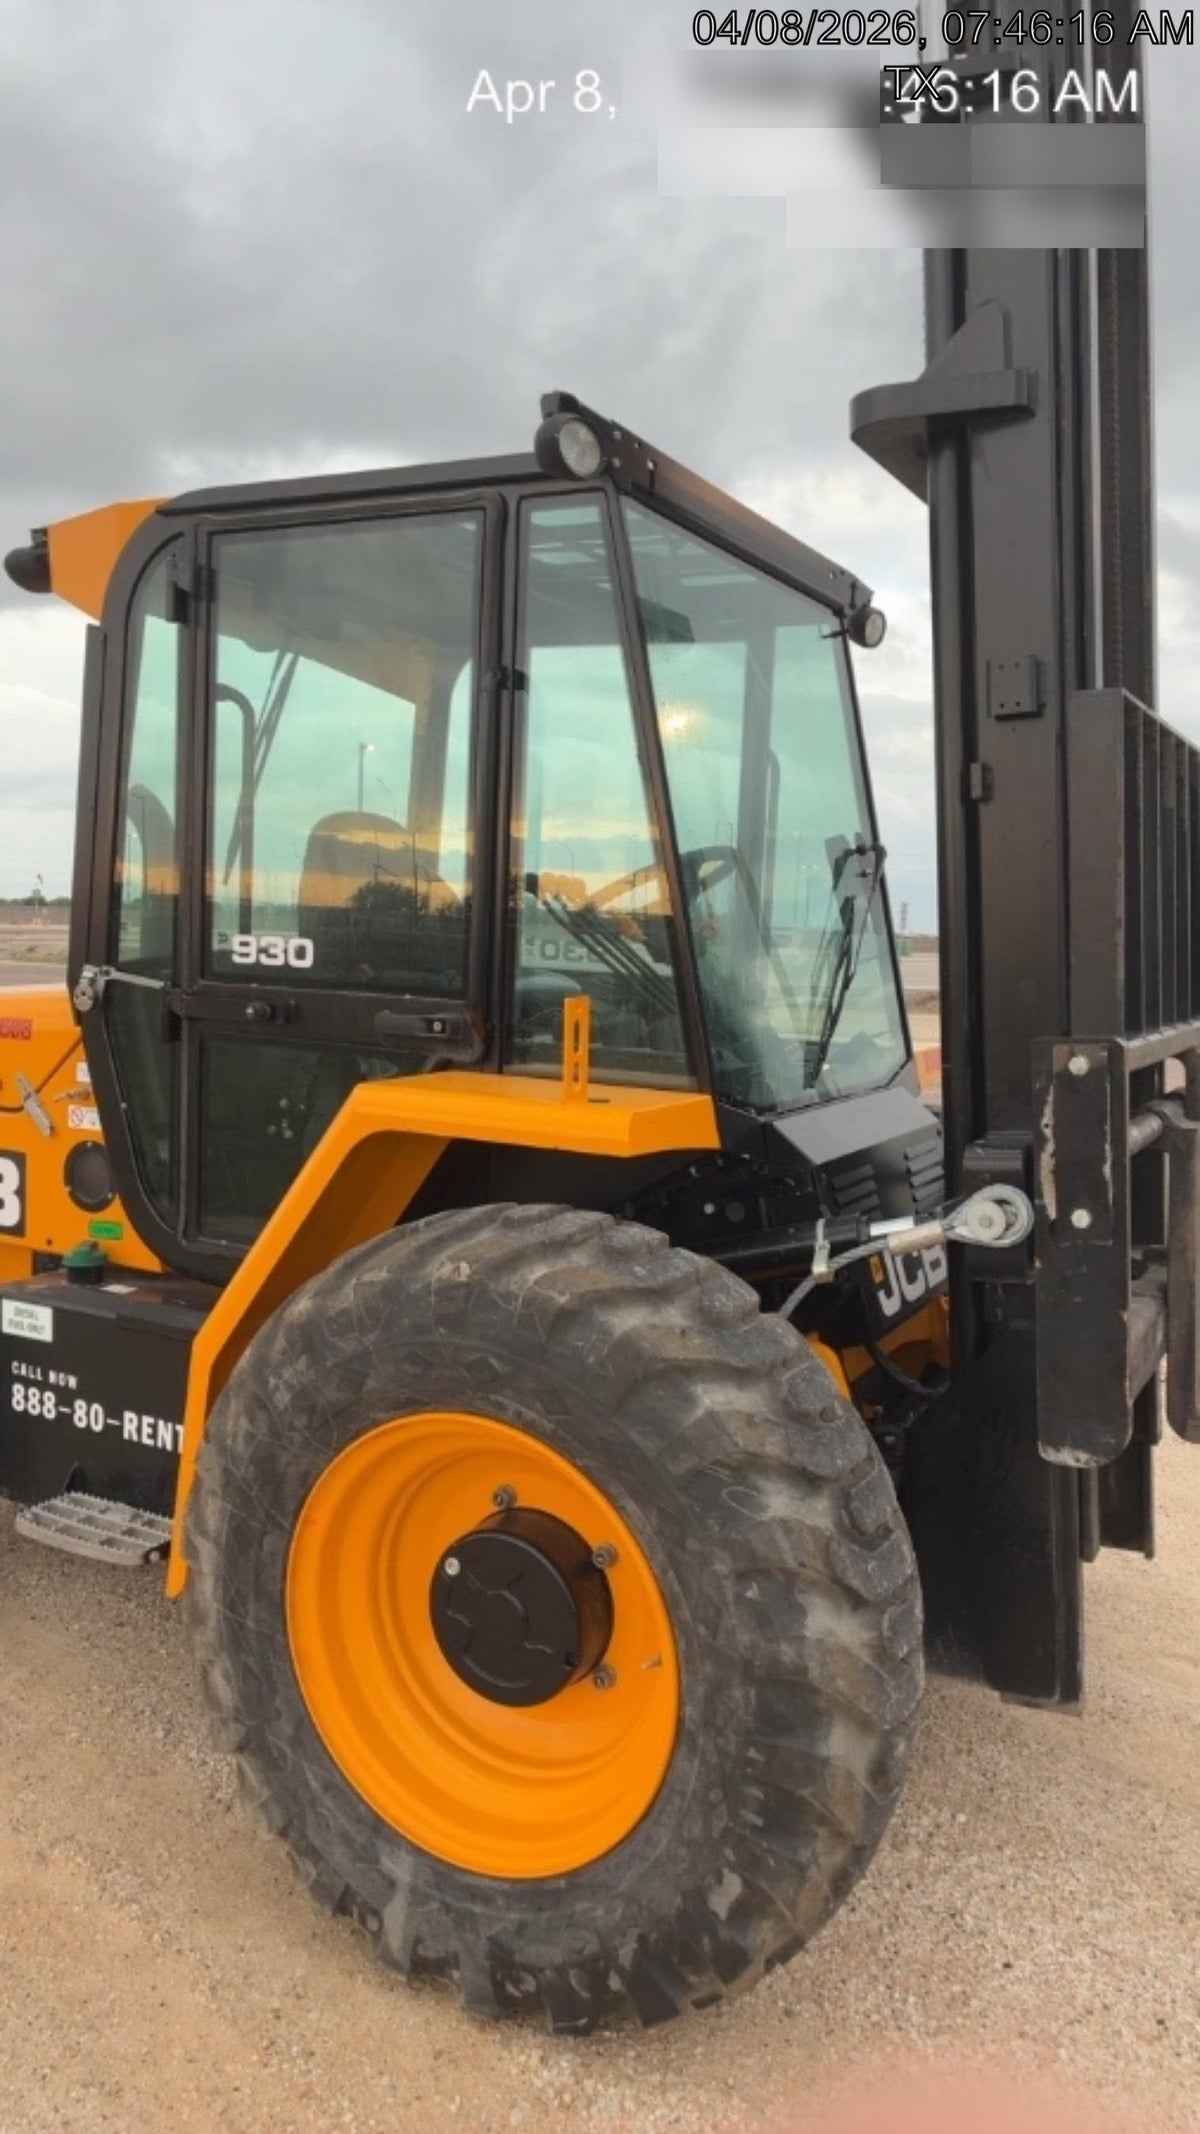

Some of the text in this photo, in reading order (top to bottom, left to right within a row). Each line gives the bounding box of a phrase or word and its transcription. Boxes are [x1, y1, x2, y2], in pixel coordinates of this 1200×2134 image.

[231, 934, 314, 968] 930
[877, 1244, 948, 1317] JCB
[11, 1360, 78, 1389] CALL NOW
[11, 1382, 185, 1454] 888-80-RENT
